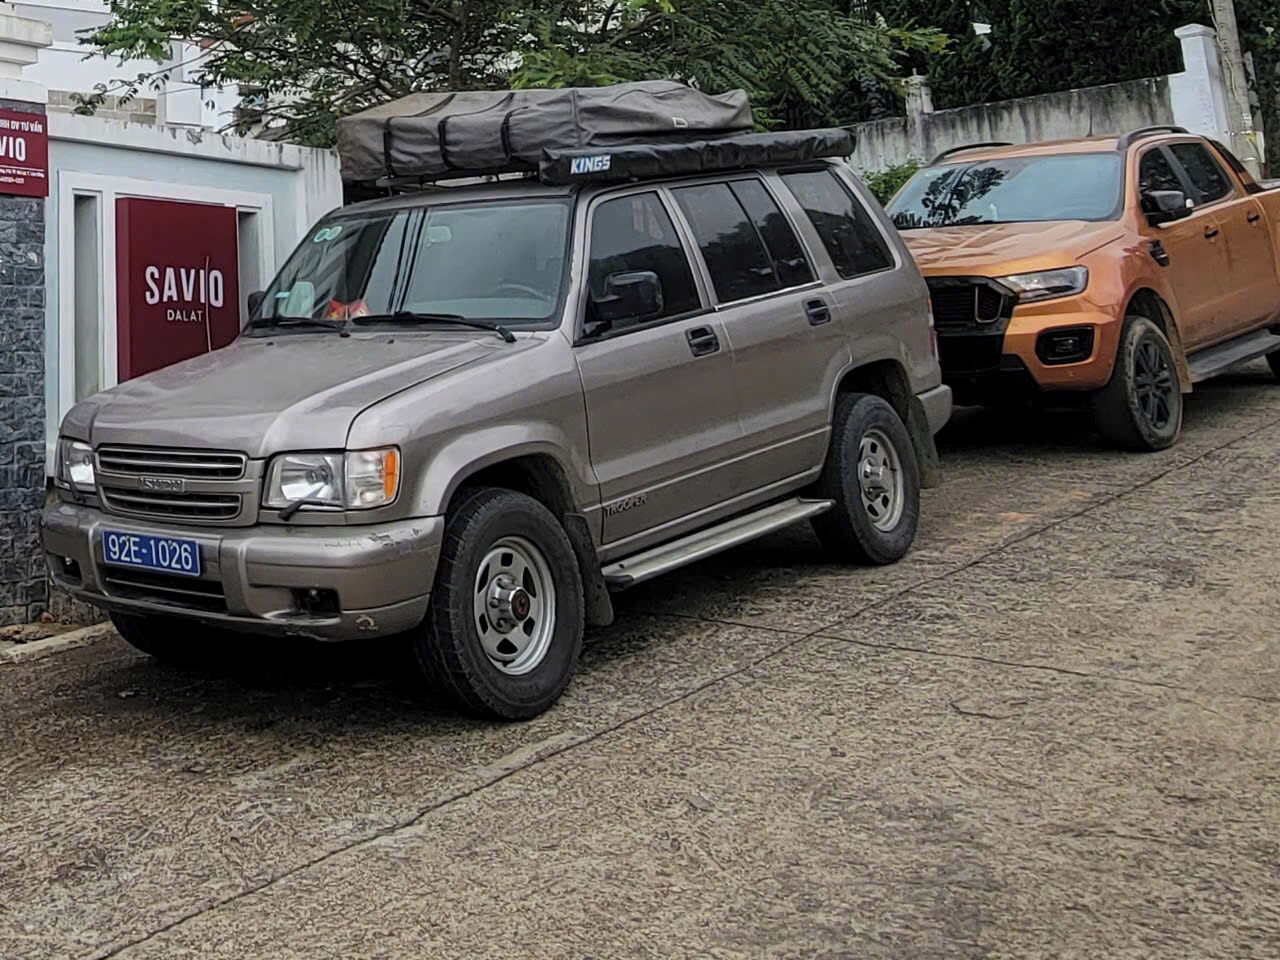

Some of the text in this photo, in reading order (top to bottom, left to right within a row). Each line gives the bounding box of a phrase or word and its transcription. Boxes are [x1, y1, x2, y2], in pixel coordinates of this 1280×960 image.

[570, 154, 611, 175] KINGS
[145, 265, 224, 308] SAVIO
[167, 309, 203, 323] DALAT
[108, 534, 193, 570] 92E-1026
